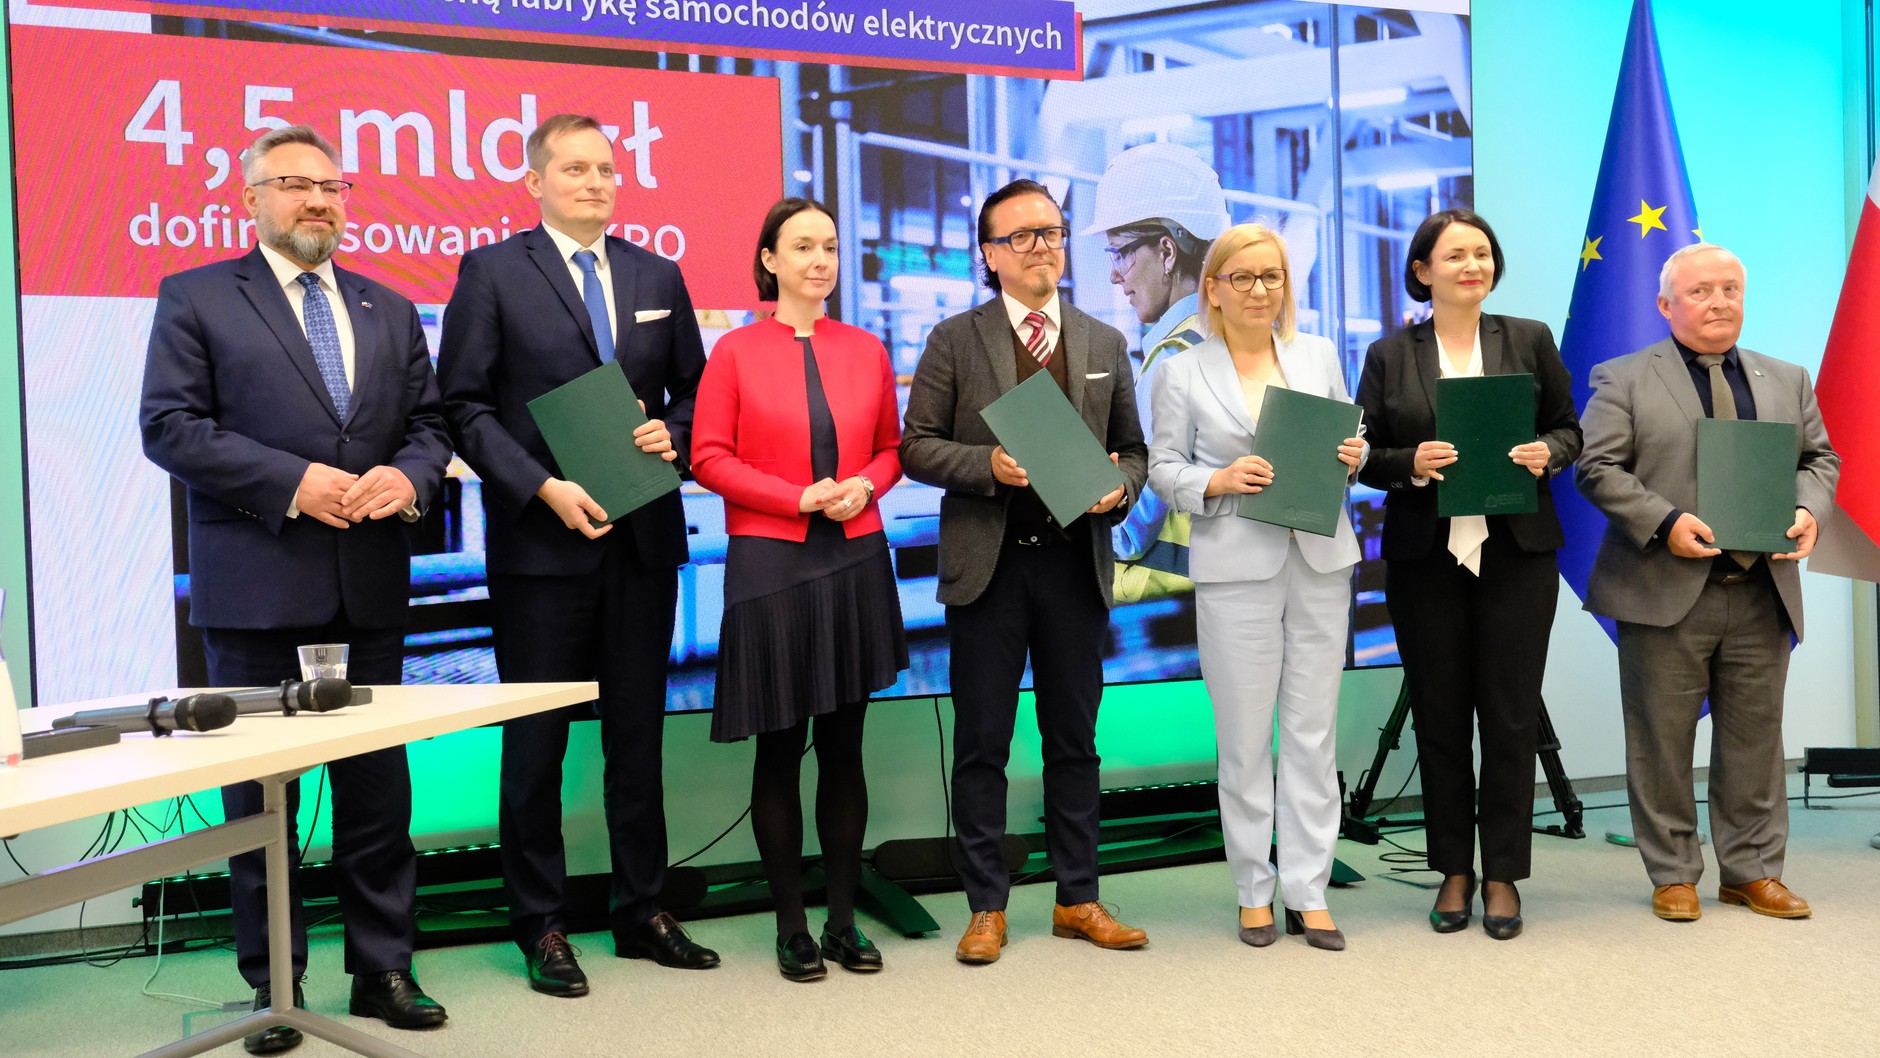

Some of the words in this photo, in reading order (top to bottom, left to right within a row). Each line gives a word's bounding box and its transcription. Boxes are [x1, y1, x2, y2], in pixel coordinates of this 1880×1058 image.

[511, 0, 637, 25] rykę
[645, 0, 854, 34] samochodów
[863, 16, 1062, 55] elektrycznych
[339, 88, 538, 182] mld
[129, 202, 533, 255] dofinsowani
